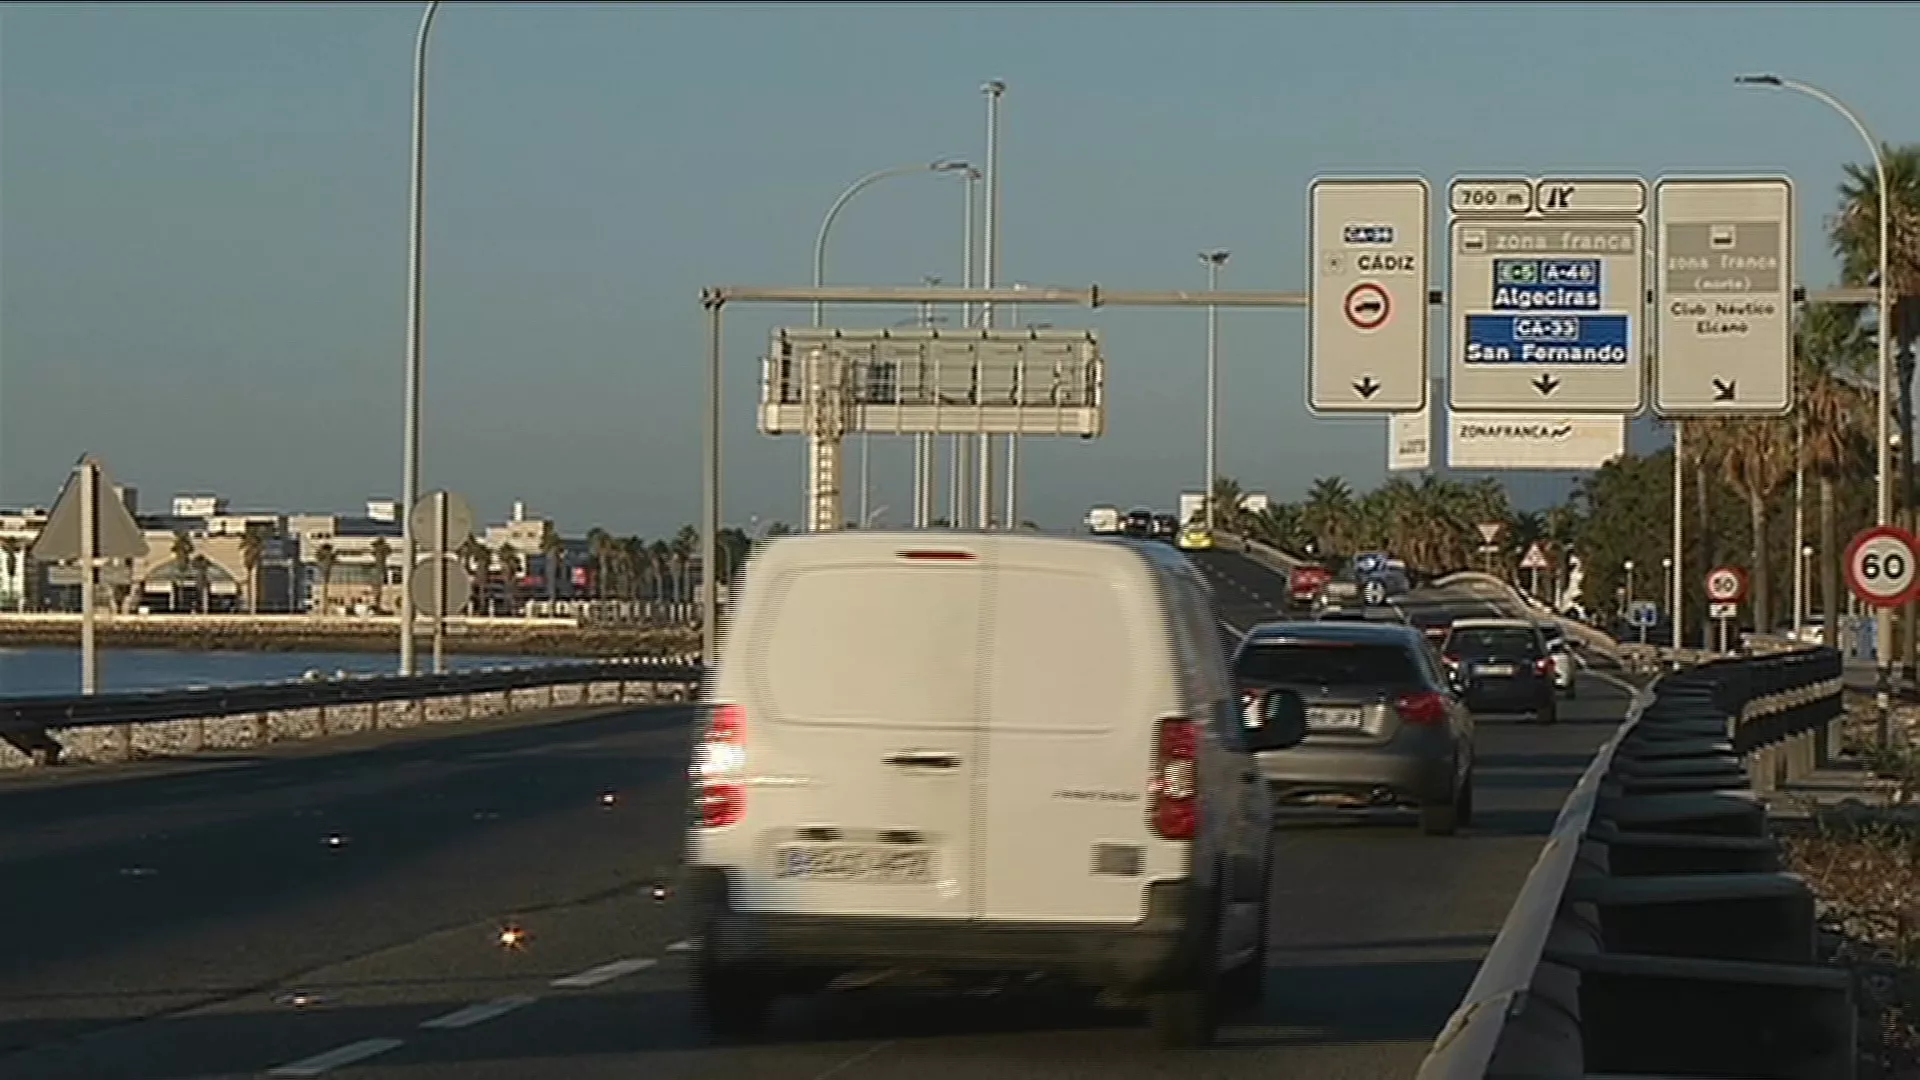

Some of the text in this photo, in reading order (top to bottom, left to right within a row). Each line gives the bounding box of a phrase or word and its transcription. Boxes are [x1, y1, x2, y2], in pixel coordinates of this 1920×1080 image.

[1462, 190, 1523, 205] 700 m
[1496, 231, 1633, 250] zona franca
[1668, 254, 1777, 270] zona franca
[1495, 287, 1599, 308] Algeciras
[1671, 302, 1706, 316] Club
[1516, 320, 1575, 338] CA-33
[1697, 321, 1749, 334] Elcano
[1467, 343, 1626, 361] San Fernando
[1861, 553, 1905, 580] 60
[1713, 576, 1733, 591] 50
